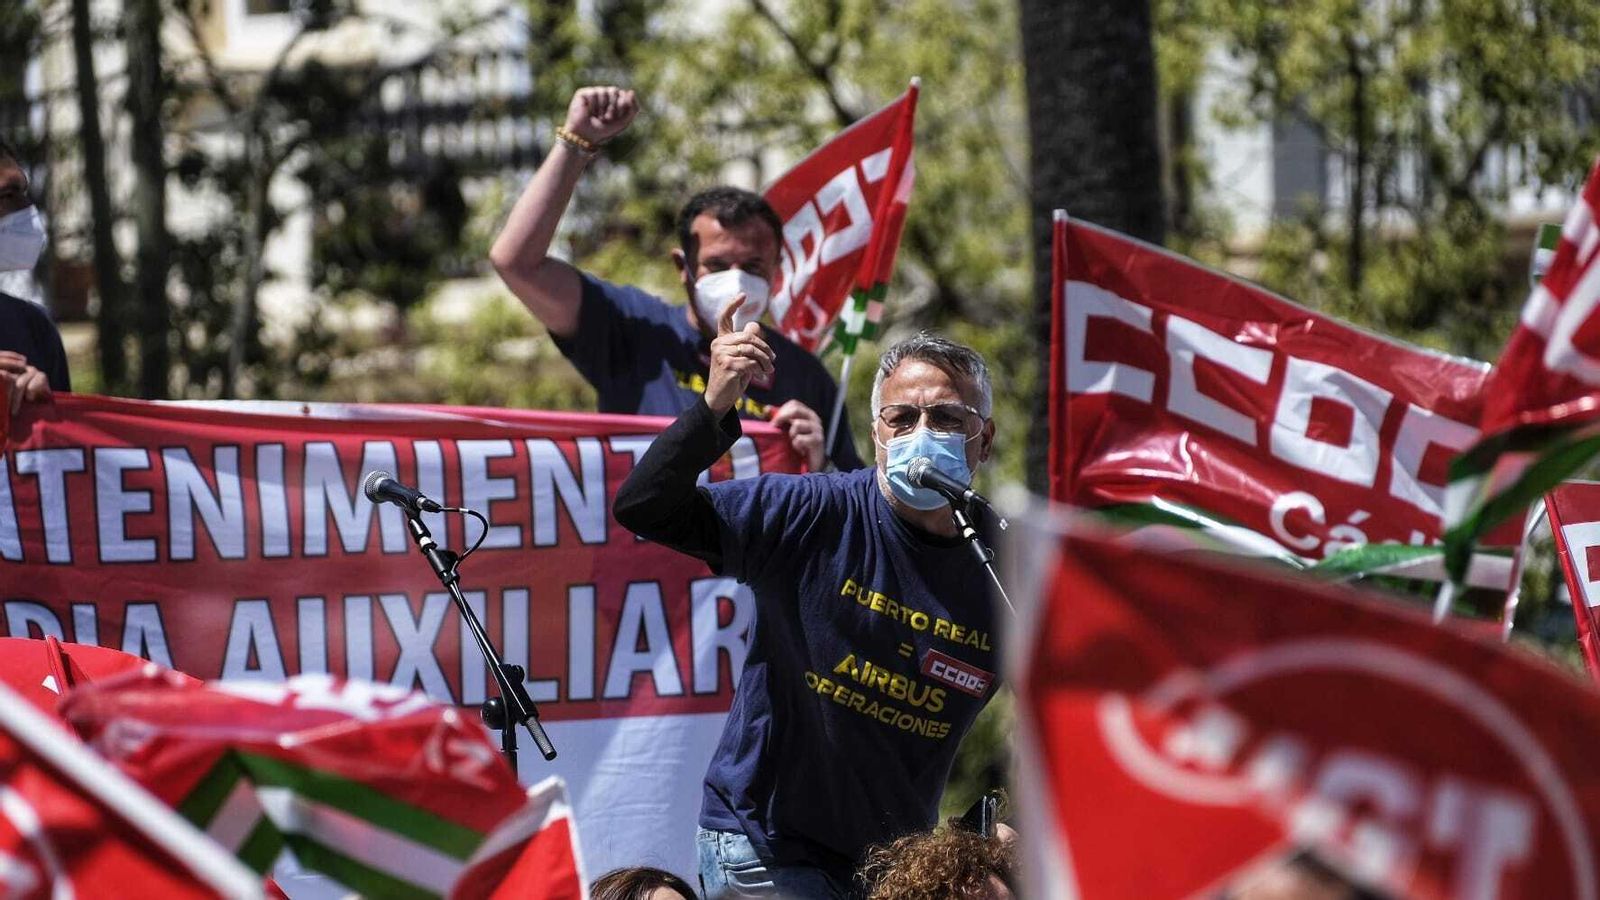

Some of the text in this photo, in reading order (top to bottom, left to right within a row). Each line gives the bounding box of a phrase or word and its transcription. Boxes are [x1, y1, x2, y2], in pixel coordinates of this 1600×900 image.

[220, 577, 757, 701] AUXILIAR
[840, 579, 991, 651] PUERTO REAL
[804, 671, 951, 738] OPERACIONES
[833, 654, 947, 713] AIRBUS
